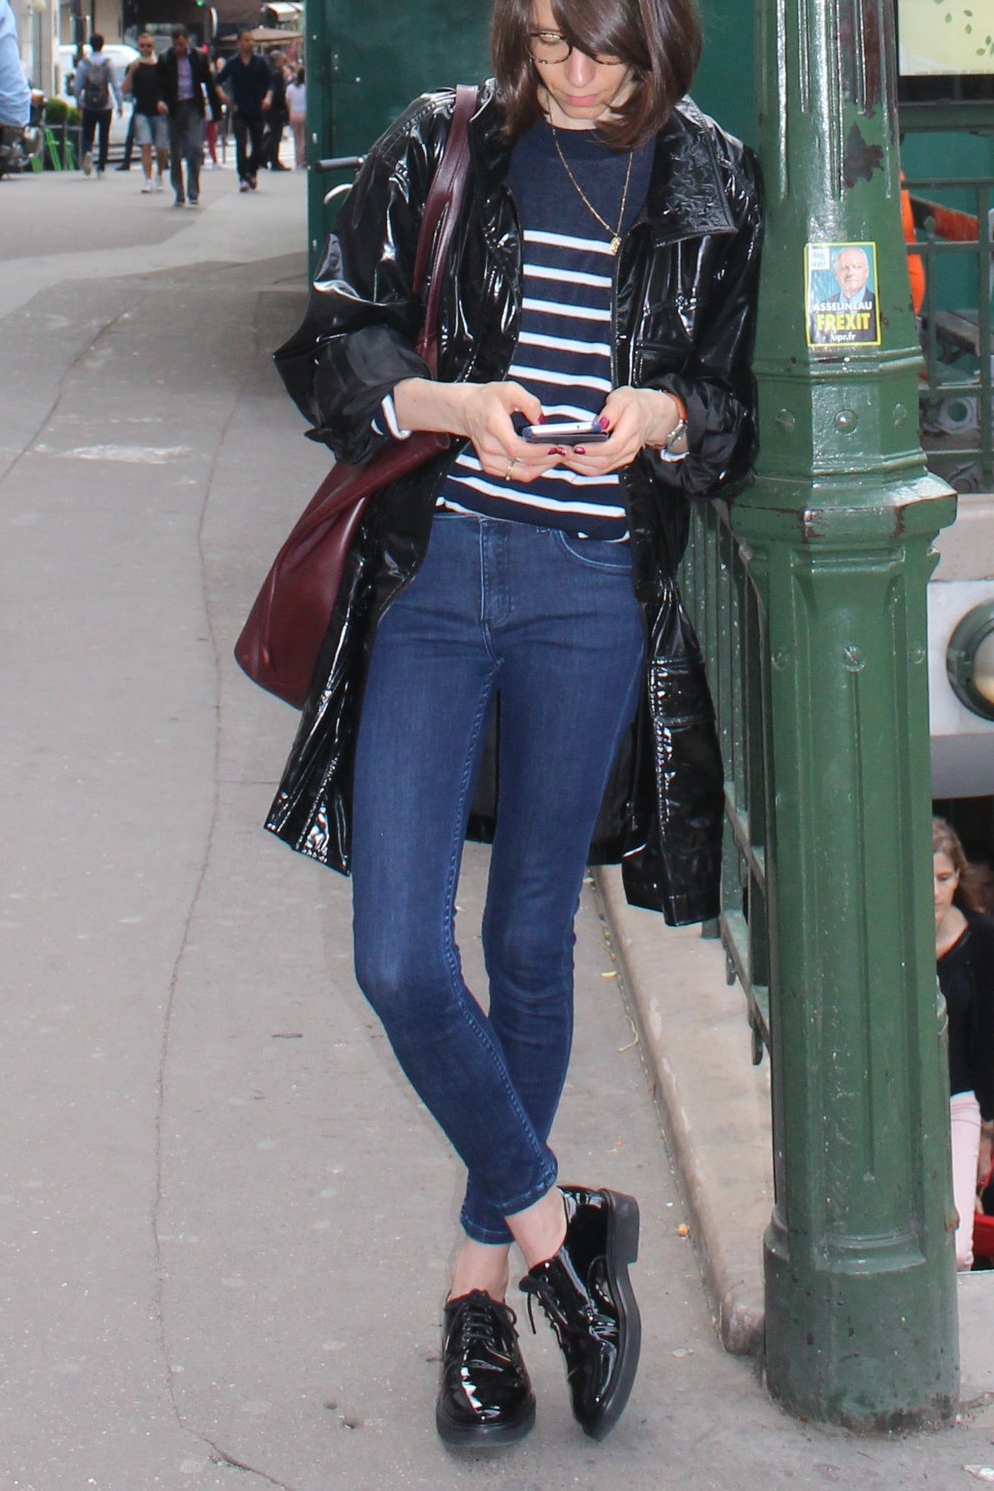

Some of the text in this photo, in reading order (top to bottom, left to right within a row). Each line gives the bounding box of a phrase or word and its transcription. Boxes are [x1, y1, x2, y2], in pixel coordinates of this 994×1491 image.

[813, 301, 873, 311] ASSELINEAU
[816, 313, 870, 330] FREXIT
[831, 332, 856, 342] upr.fr
